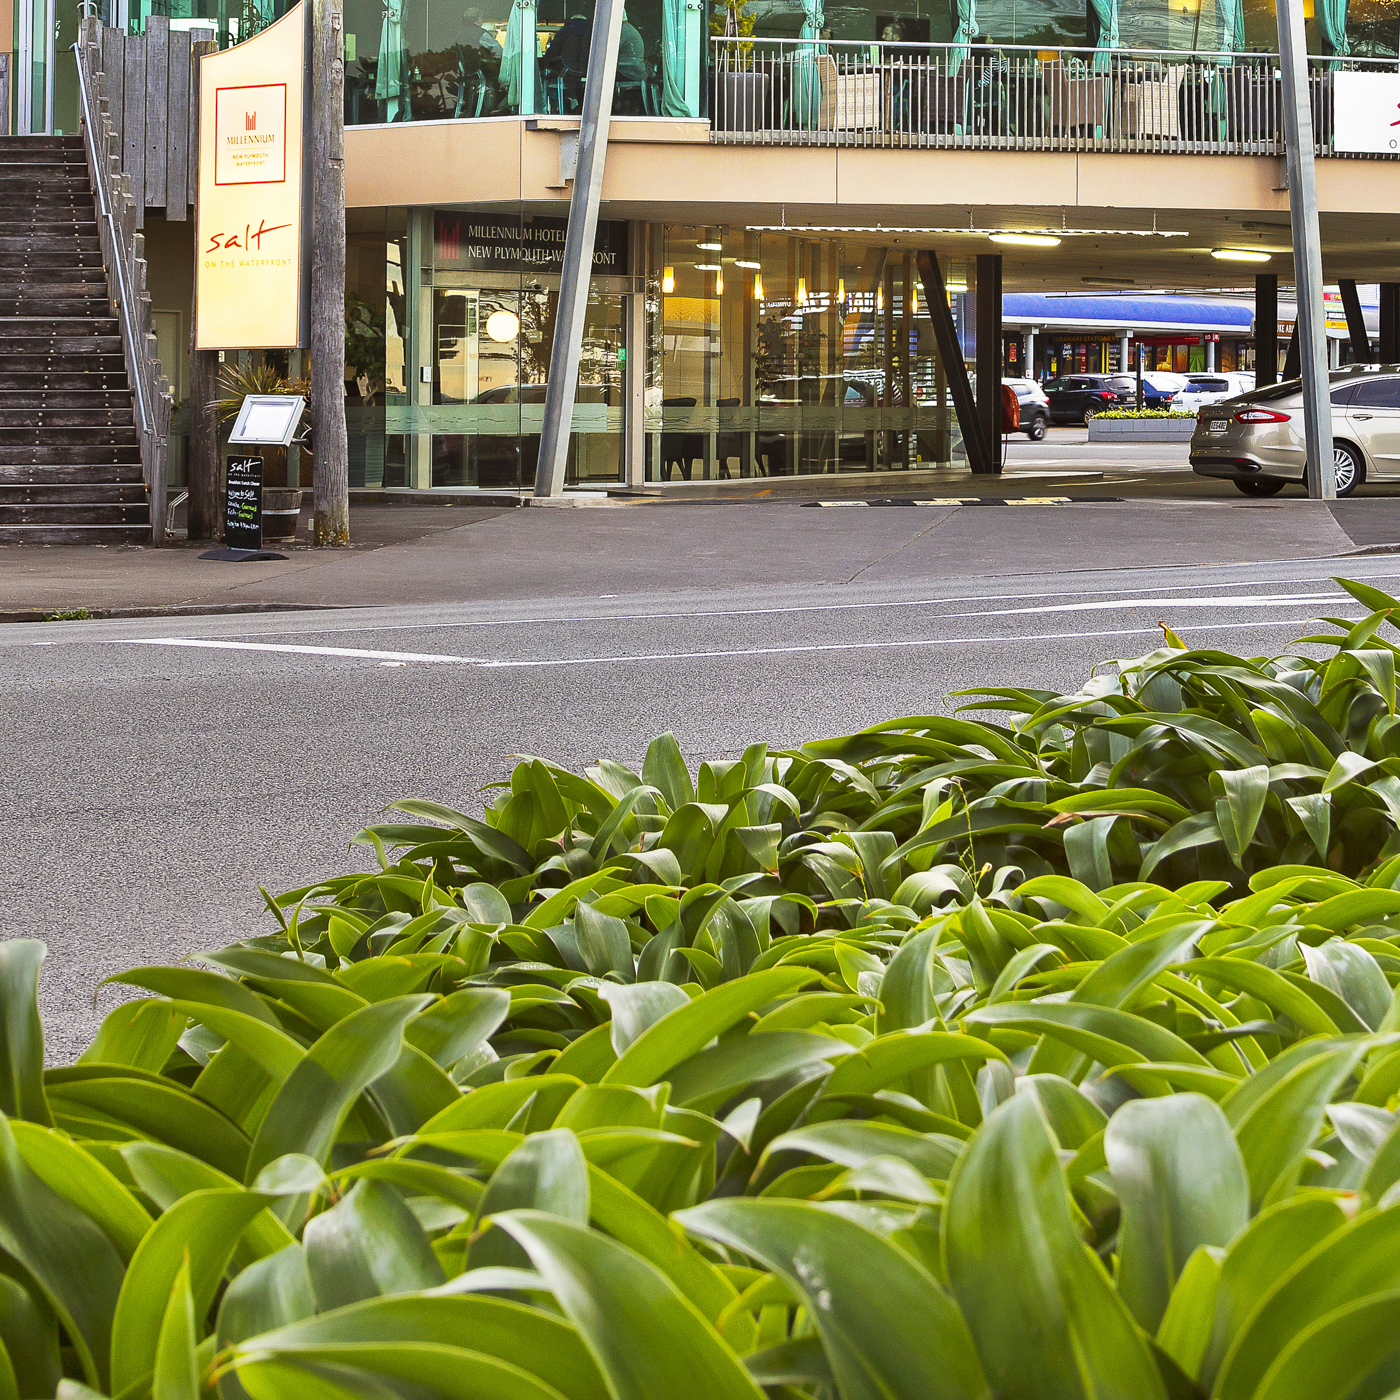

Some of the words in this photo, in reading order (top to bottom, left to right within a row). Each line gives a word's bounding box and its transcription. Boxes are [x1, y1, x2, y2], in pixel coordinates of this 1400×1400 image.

[226, 134, 274, 145] MILLENNIUM
[205, 218, 292, 254] salt
[468, 225, 532, 240] MILLENNIUM
[468, 246, 492, 258] NEW
[494, 246, 550, 261] PLYMOUTH
[239, 258, 292, 266] WATERFRONT
[230, 459, 261, 472] salt
